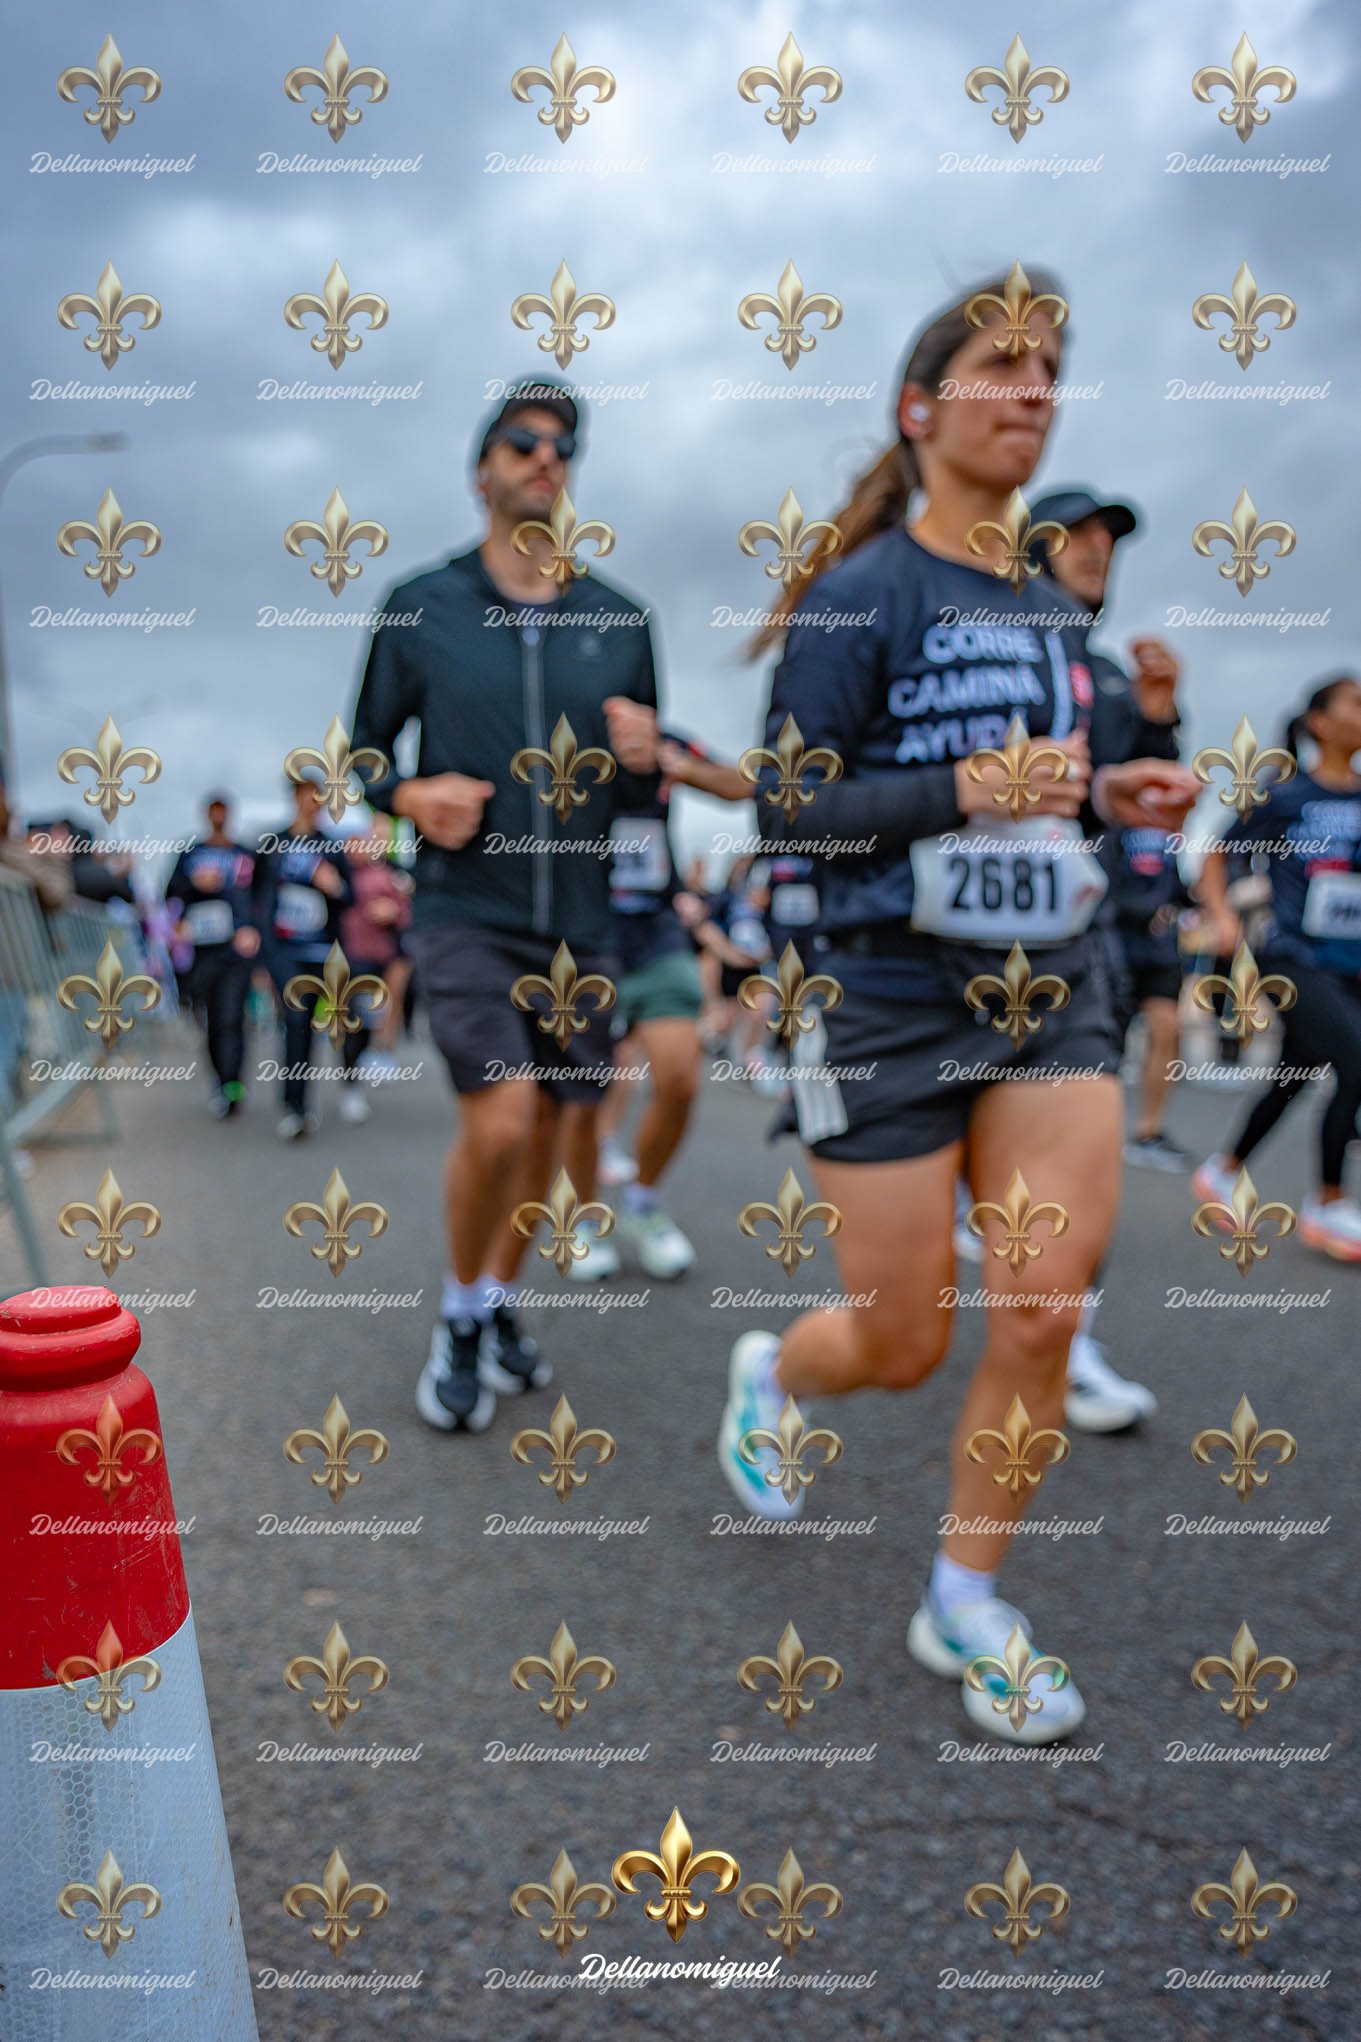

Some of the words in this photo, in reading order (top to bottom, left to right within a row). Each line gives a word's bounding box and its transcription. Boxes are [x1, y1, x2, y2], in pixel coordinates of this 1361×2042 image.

[923, 623, 1044, 663] CORRE
[888, 665, 1046, 718] CAMINA
[949, 857, 1056, 911] 2681
